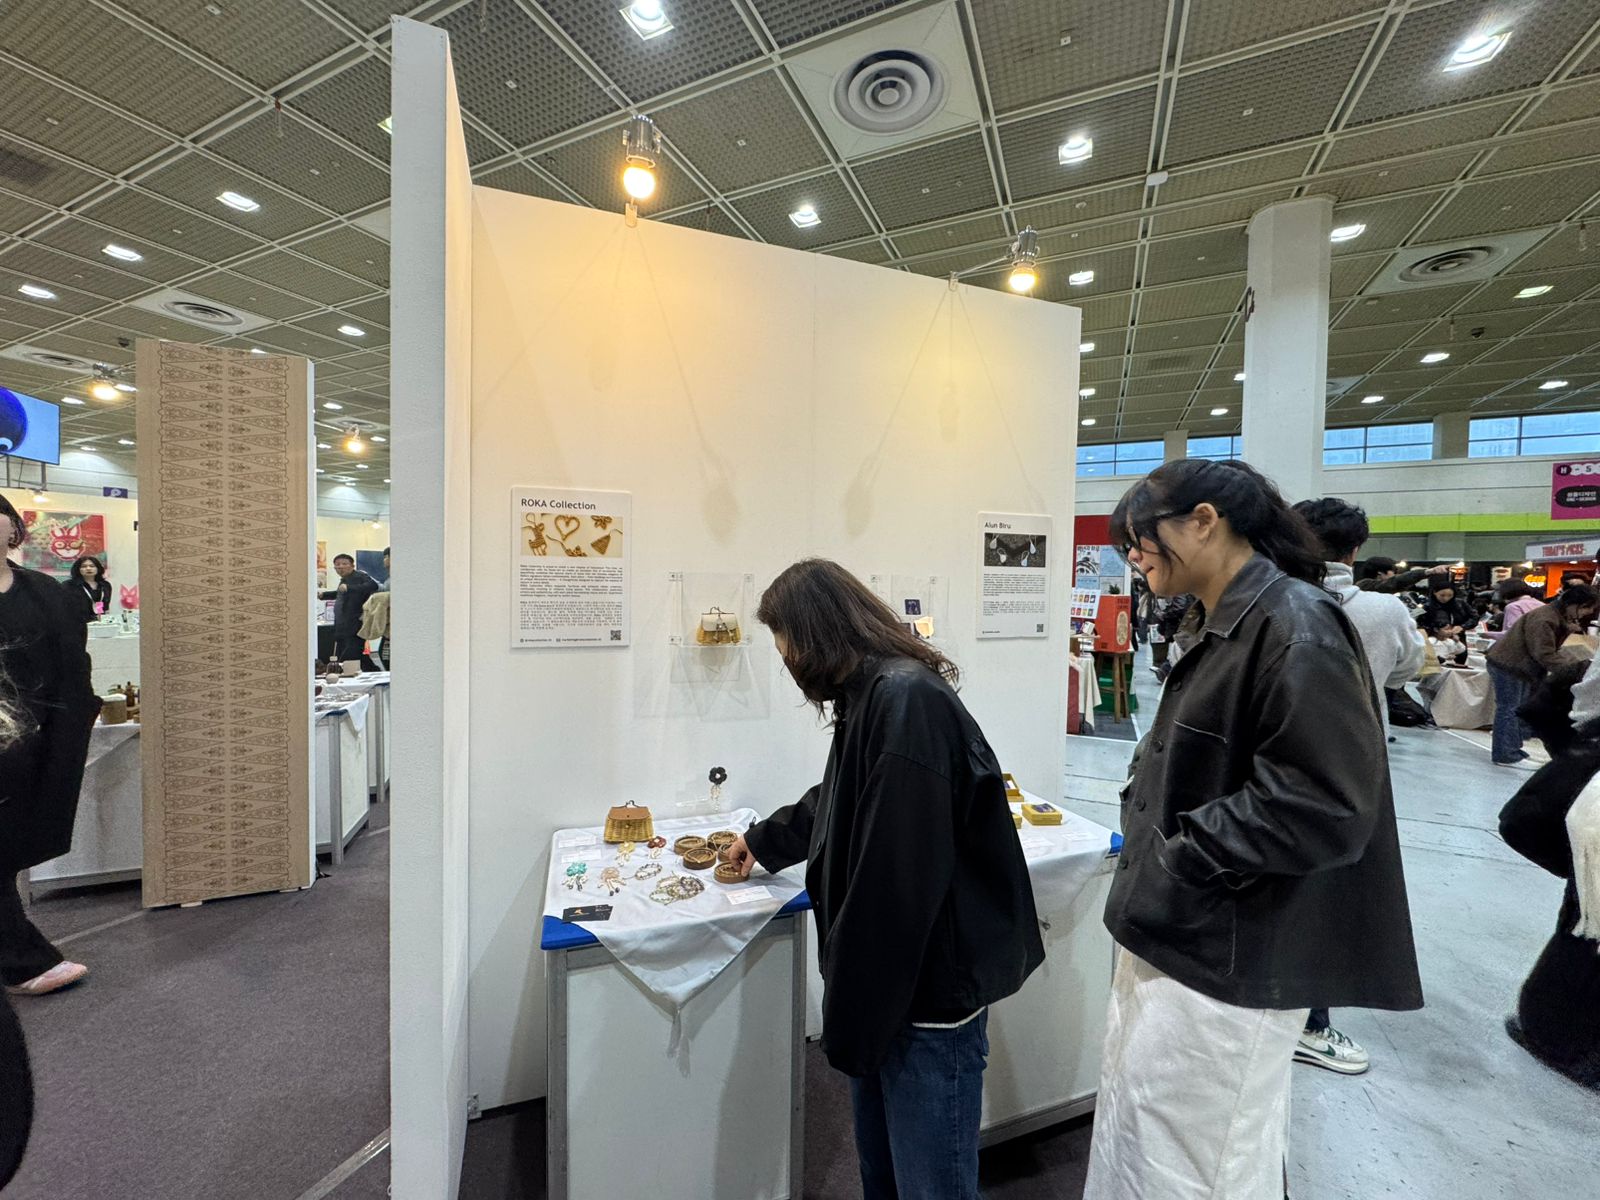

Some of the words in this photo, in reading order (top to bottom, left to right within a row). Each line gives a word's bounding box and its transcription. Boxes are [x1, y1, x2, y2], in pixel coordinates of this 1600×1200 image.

[521, 498, 547, 508] ROKA
[549, 500, 596, 510] Collection
[984, 521, 998, 529] Alun
